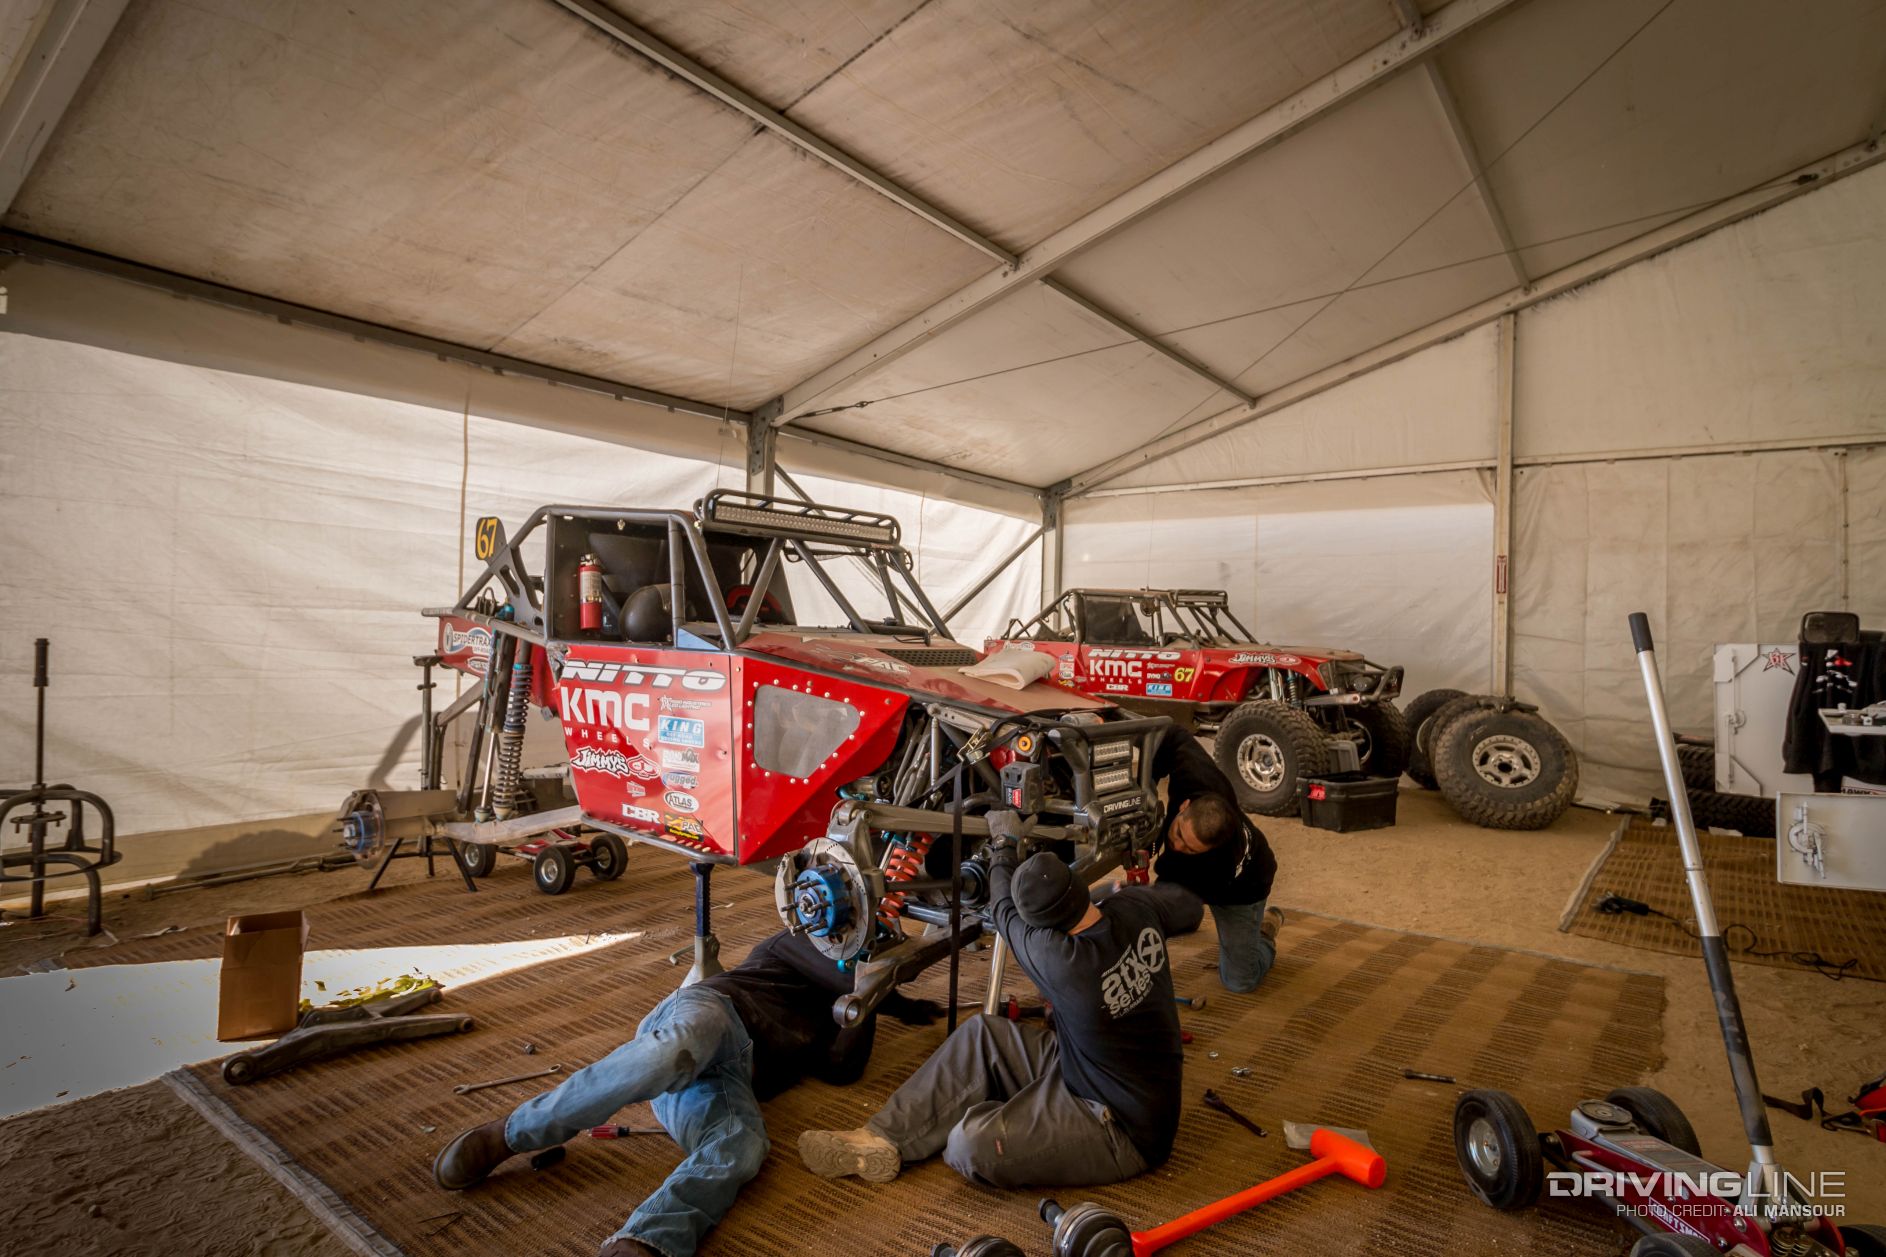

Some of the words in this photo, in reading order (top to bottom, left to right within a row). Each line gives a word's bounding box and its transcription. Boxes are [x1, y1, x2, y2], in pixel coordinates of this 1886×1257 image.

[477, 518, 497, 559] 67
[1088, 648, 1181, 660] NITTO
[562, 660, 727, 692] NITTO
[1090, 677, 1142, 685] WHEELS
[1174, 667, 1195, 682] 67
[660, 719, 702, 734] KING
[565, 726, 650, 747] WHEELS
[668, 794, 692, 808] ATLAS
[1110, 970, 1151, 1015] series
